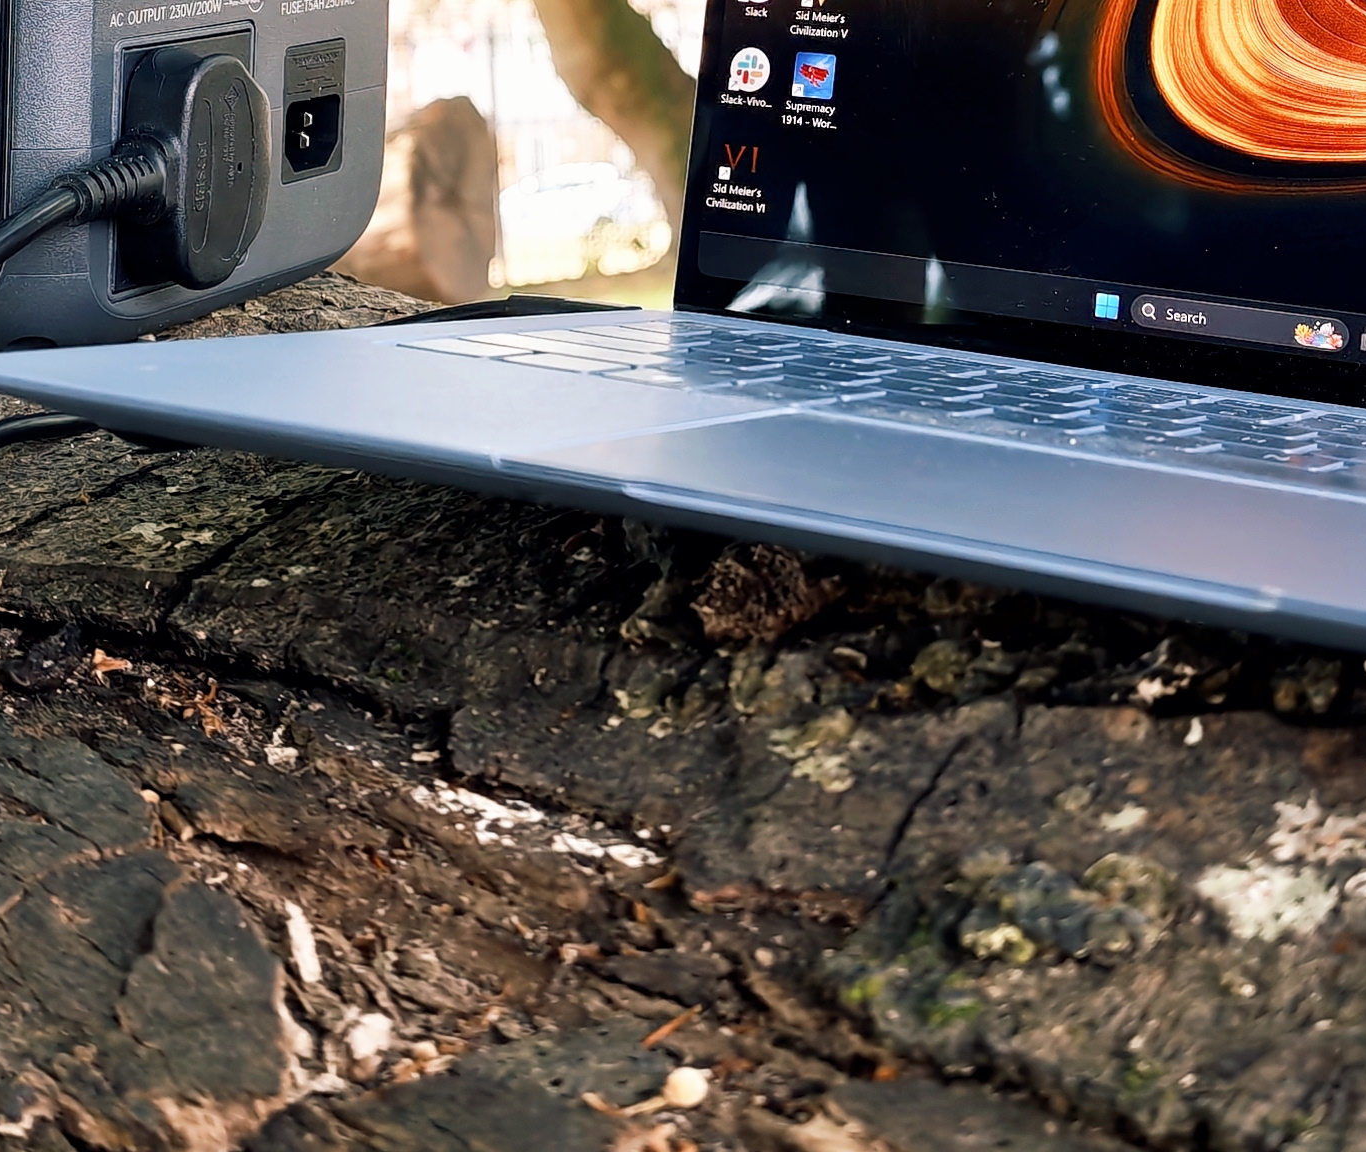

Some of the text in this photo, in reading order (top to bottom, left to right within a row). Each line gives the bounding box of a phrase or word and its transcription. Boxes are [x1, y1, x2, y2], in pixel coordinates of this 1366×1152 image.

[109, 12, 125, 28] AC
[127, 6, 167, 25] OUTPUT
[169, 0, 223, 19] 230V/200W
[745, 7, 768, 18] Slack
[795, 10, 845, 24] Sid Meier's
[789, 25, 849, 39] Civilization V
[786, 100, 835, 116] Supremacy
[781, 115, 803, 126] 1914
[713, 183, 762, 198] Sid Meier's
[705, 197, 766, 213] Civilization VI
[1165, 307, 1207, 326] Search
